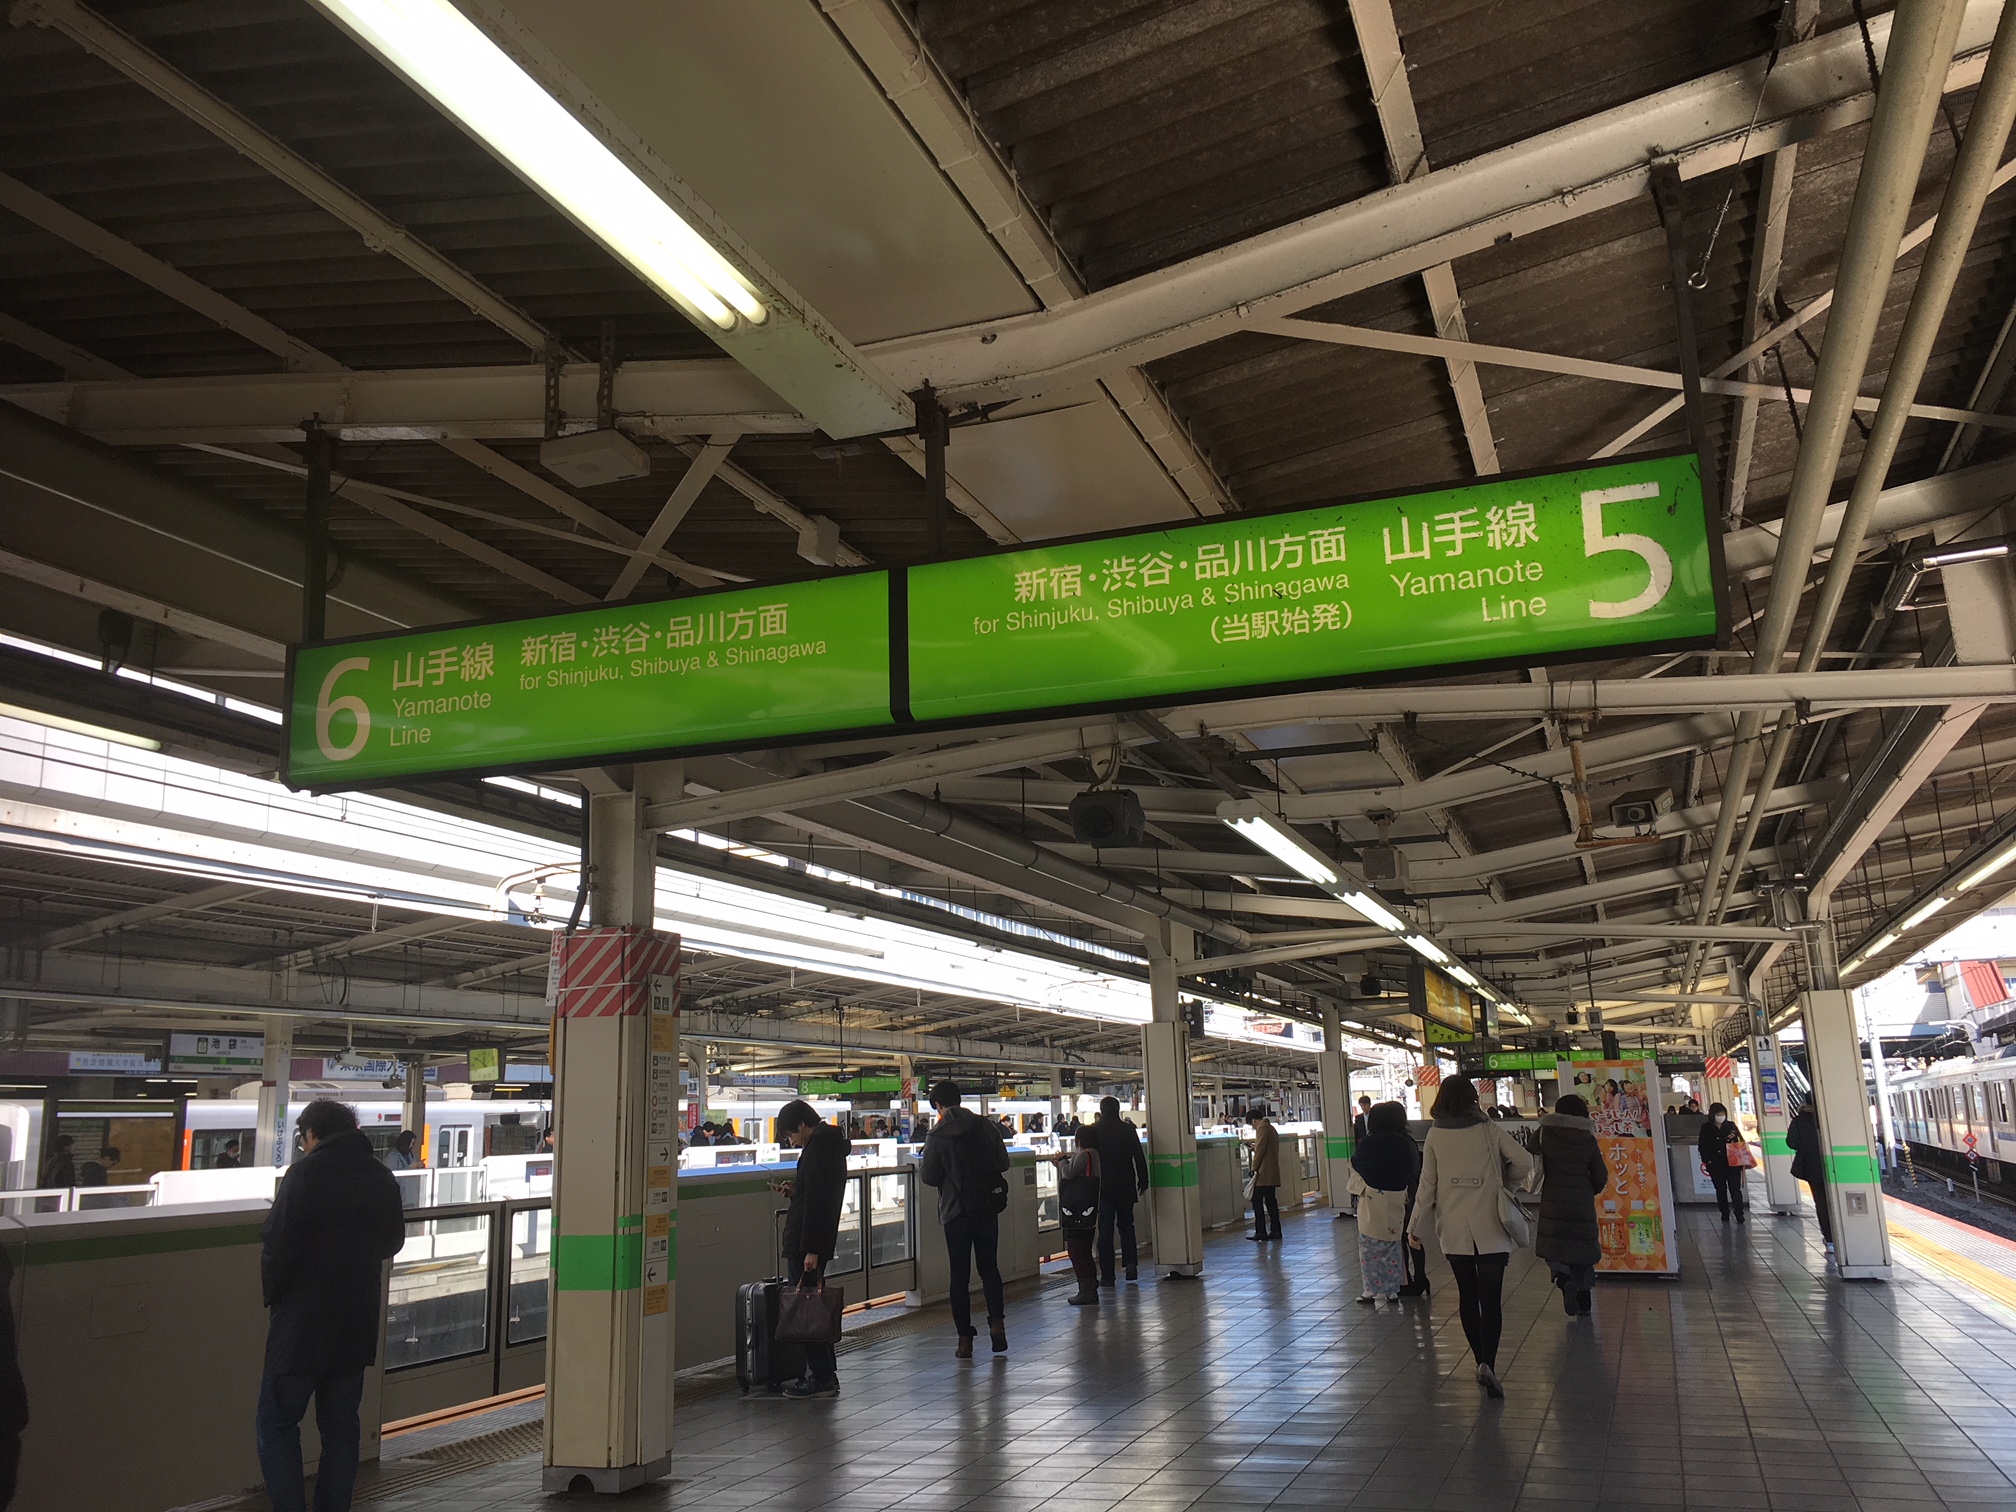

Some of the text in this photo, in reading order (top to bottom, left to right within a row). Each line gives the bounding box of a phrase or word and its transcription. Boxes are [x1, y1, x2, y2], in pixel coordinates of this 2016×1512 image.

[1382, 500, 1540, 565] 山手線
[1580, 482, 1673, 621] 5
[1390, 559, 1545, 598] Yamanote
[973, 573, 1351, 635] for Shinjuku, Shibuya & Shinagawa
[1481, 594, 1549, 624] Line
[392, 642, 495, 691] 山手線
[519, 639, 828, 691] for Shinjuku, Shibuya & Shinagawa
[315, 656, 371, 762] 6
[392, 691, 492, 718] Yamanote
[389, 725, 431, 747] Line
[211, 1037, 238, 1050] 池袋
[1488, 1054, 1498, 1069] 6
[801, 1080, 809, 1093] 8
[1609, 1143, 1629, 1195] ホッと
